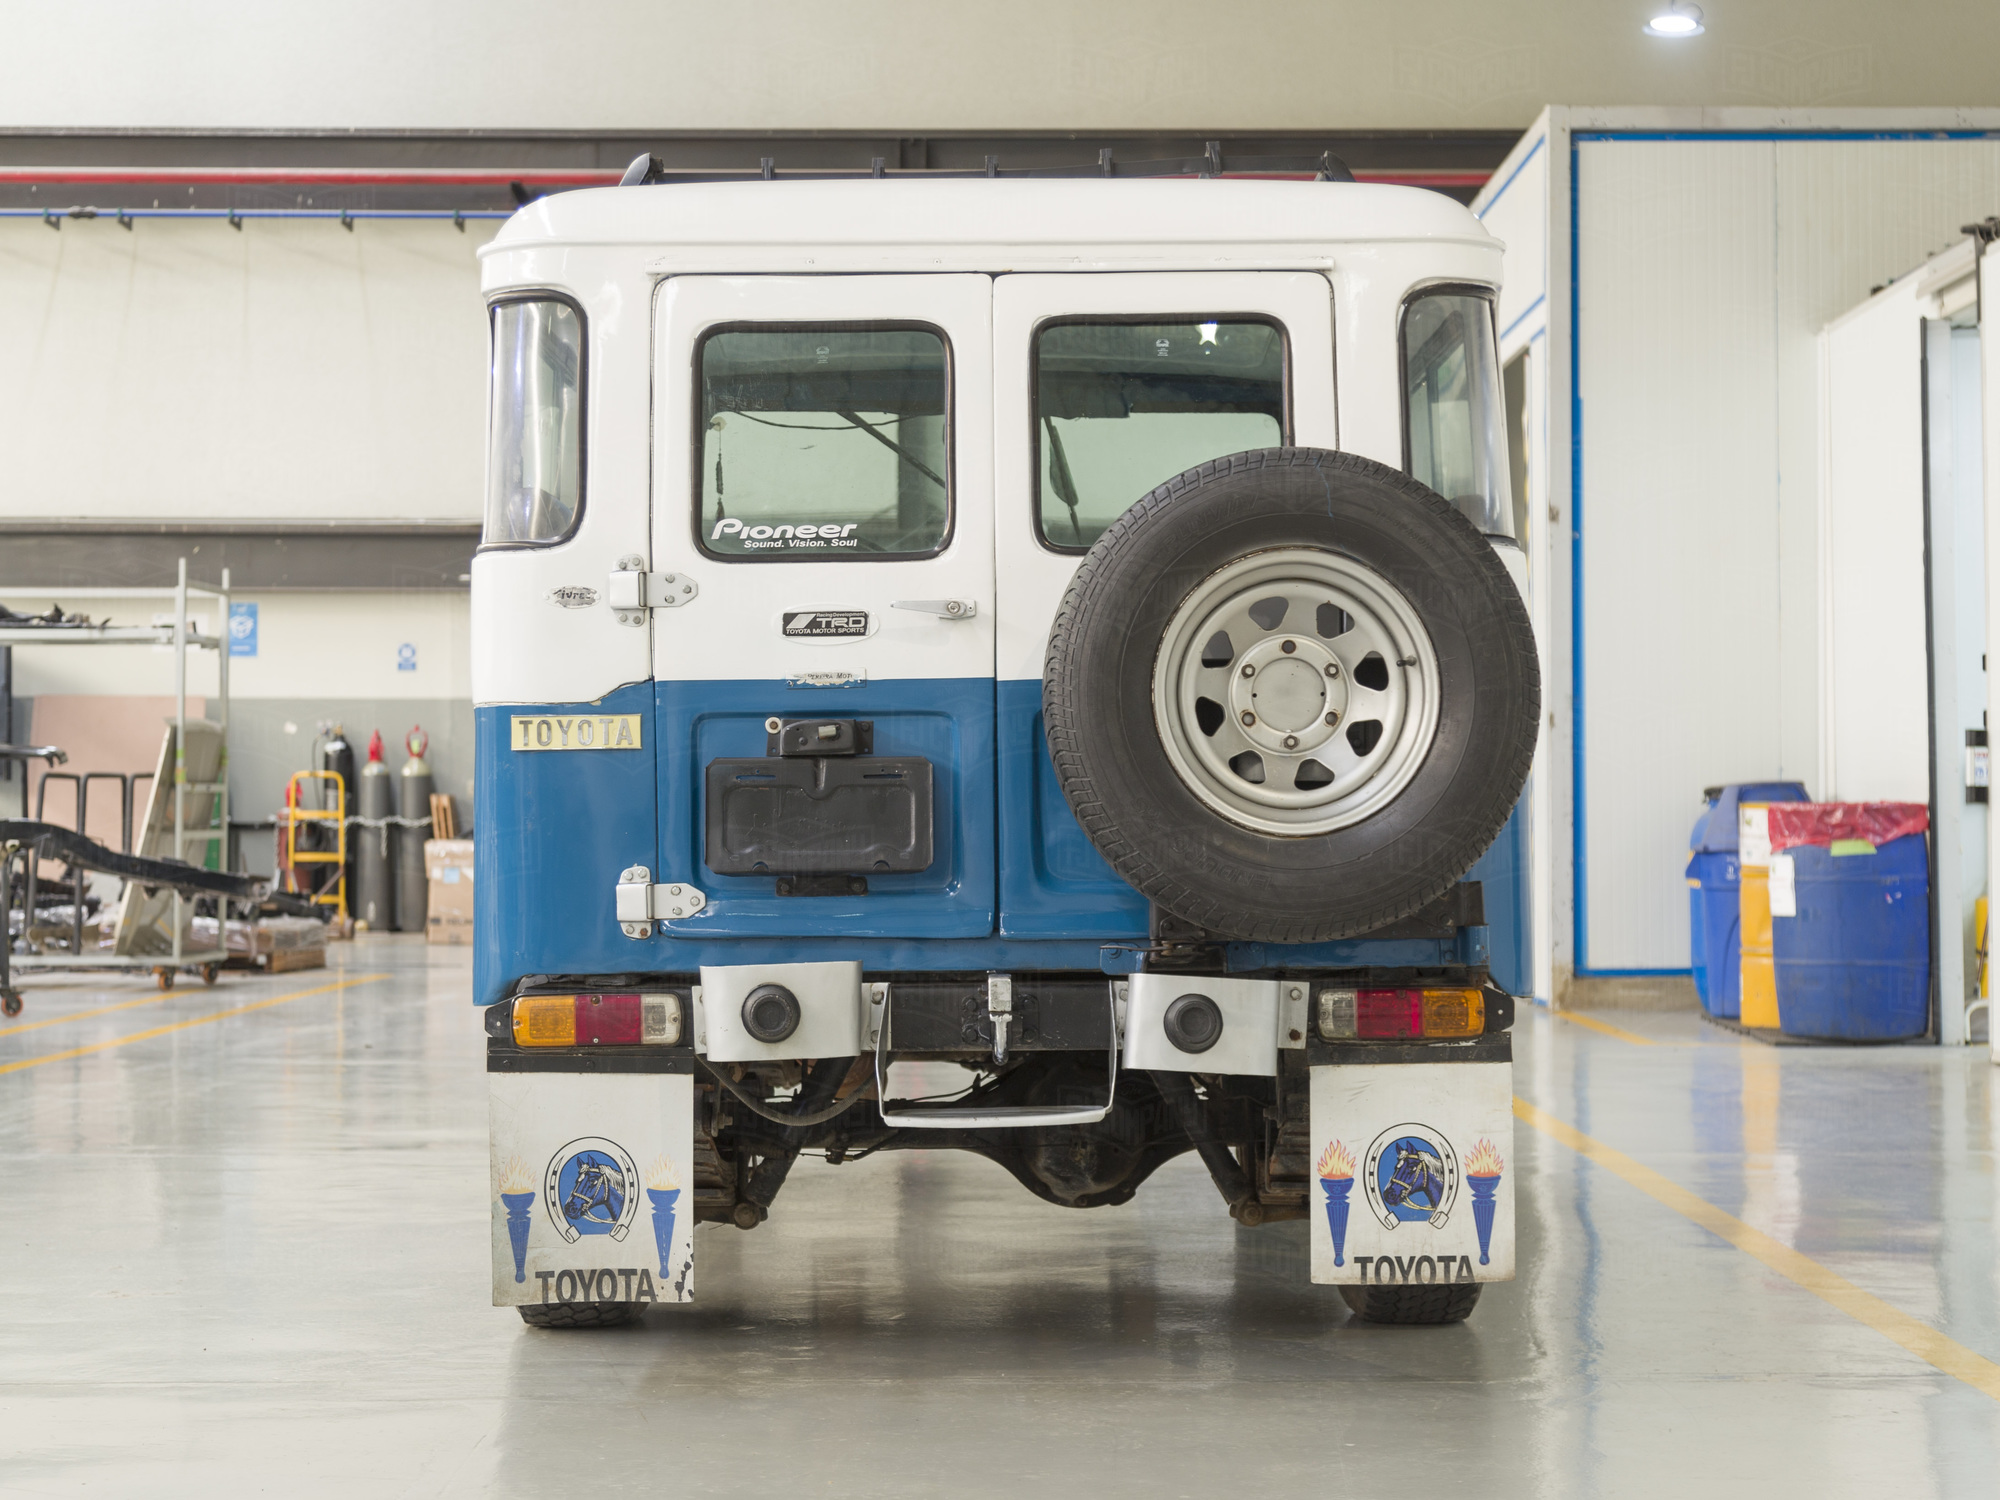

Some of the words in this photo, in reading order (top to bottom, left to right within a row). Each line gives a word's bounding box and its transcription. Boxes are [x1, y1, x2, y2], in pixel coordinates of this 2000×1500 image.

[711, 518, 858, 540] Pioneer
[744, 539, 785, 549] Sound.
[788, 538, 827, 548] Vision.
[830, 538, 858, 547] Soul
[816, 617, 865, 628] TRD
[518, 717, 633, 747] TOYOTA
[1353, 1255, 1476, 1285] TOYOTA
[535, 1268, 658, 1304] TOYOTA
